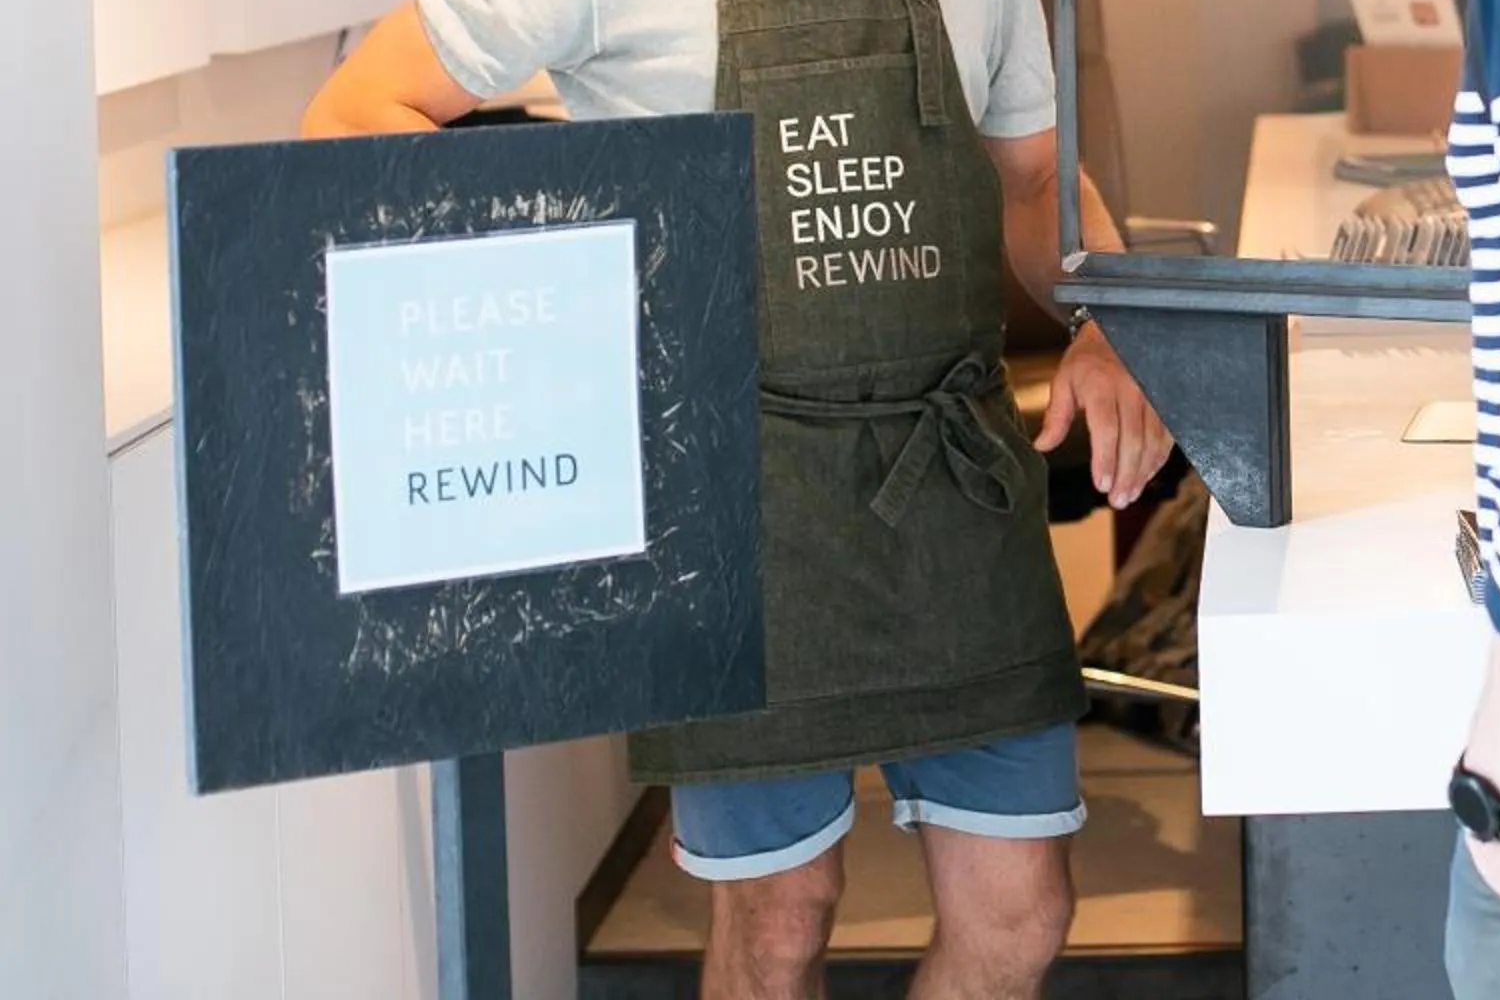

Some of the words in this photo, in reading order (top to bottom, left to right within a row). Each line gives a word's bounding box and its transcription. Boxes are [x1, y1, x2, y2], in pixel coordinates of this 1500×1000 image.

[779, 113, 855, 153] EAT
[786, 155, 905, 198] SLEEP
[791, 200, 917, 244] ENJOY
[795, 245, 941, 290] REWIND
[400, 286, 557, 336] PLEASE
[401, 348, 513, 393] WAIT
[405, 404, 515, 451] HERE
[408, 453, 579, 505] REWIND
